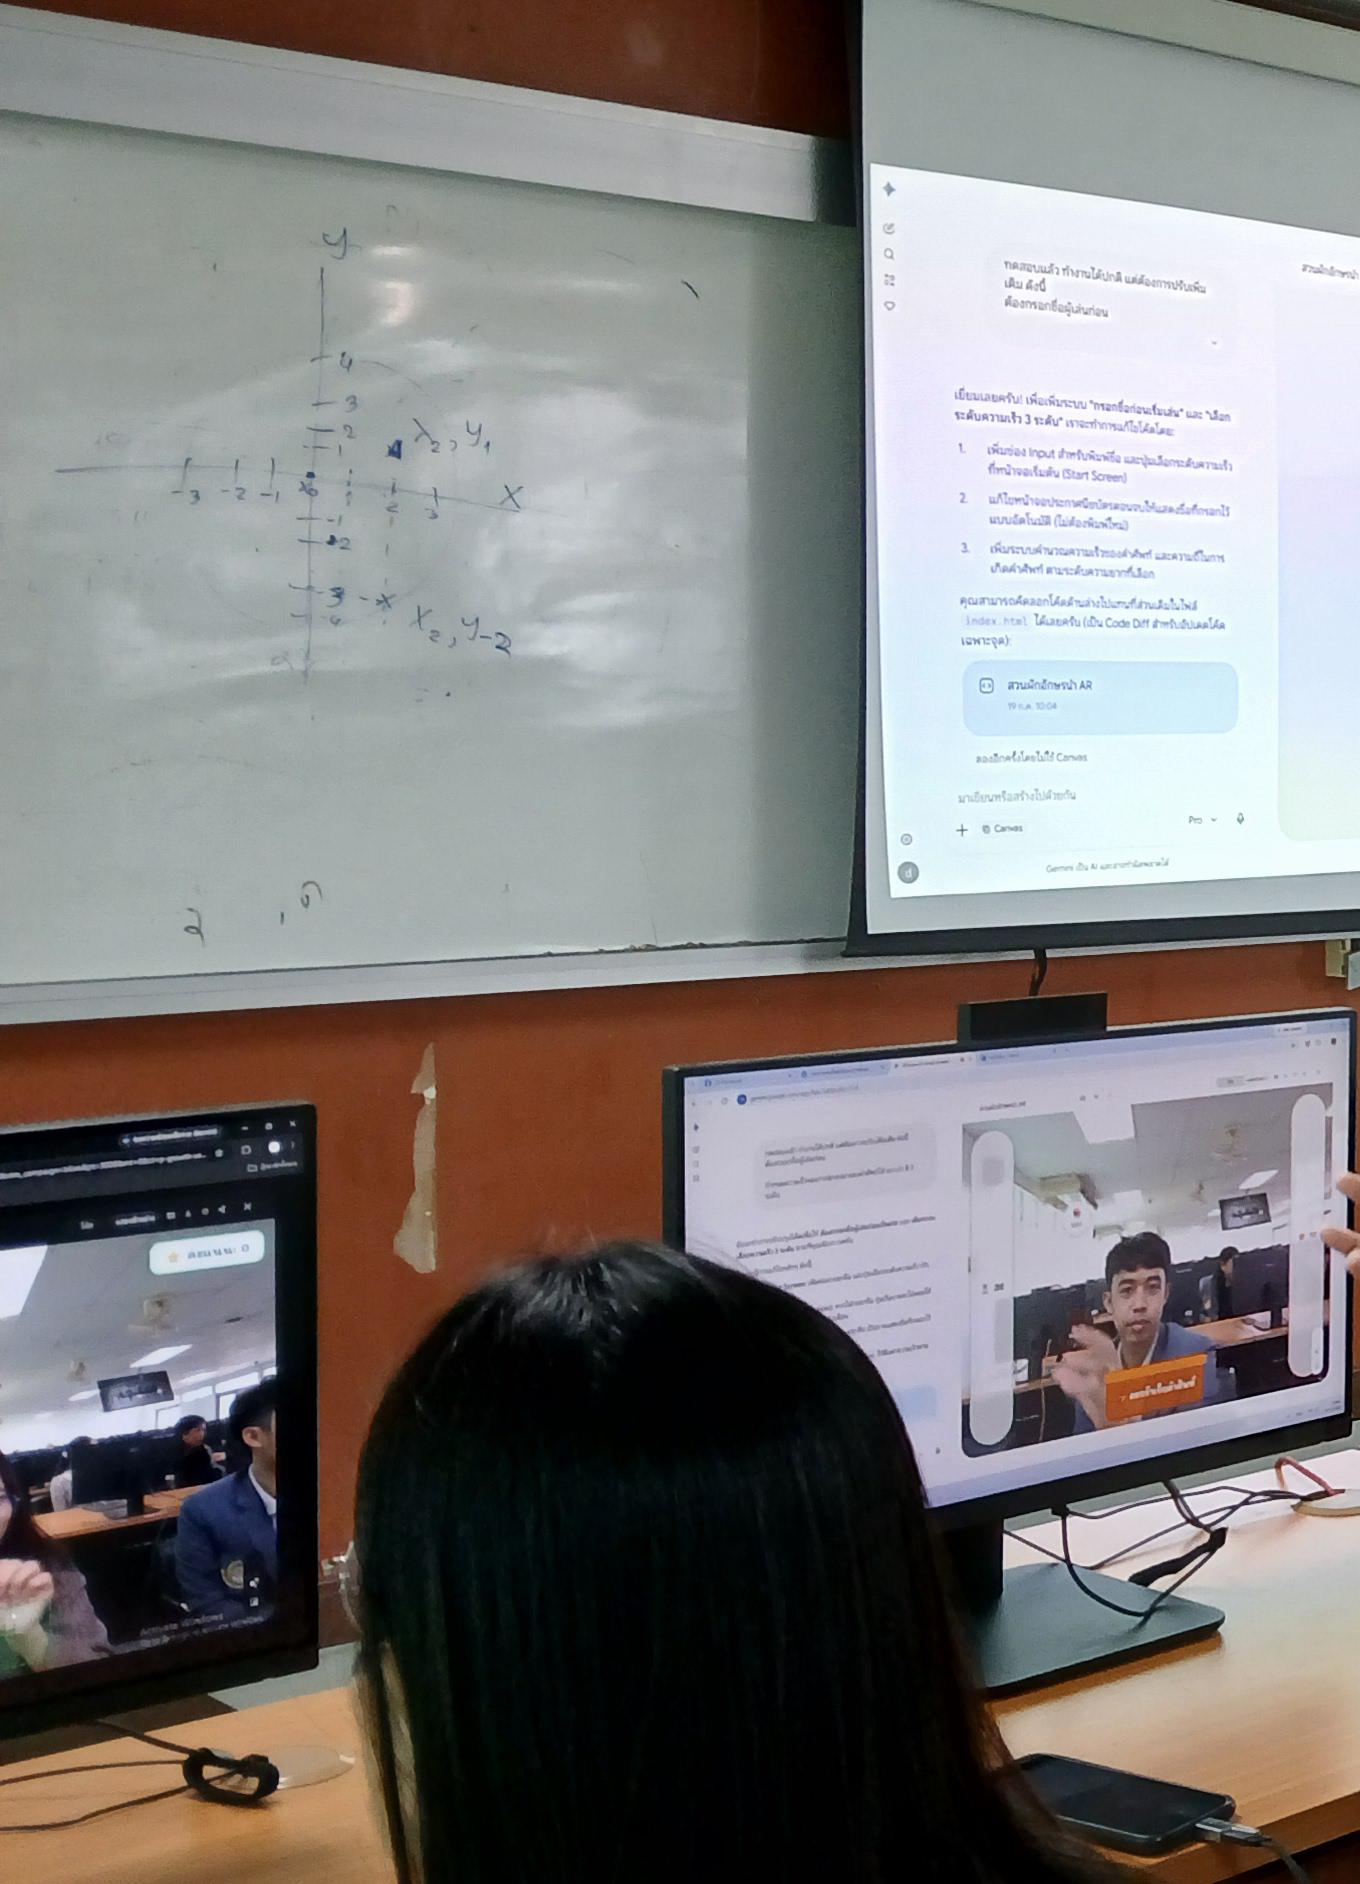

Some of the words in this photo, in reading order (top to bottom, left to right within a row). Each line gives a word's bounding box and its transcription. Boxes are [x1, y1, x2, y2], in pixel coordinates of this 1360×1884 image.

[1025, 414, 1032, 425] 3
[1029, 447, 1055, 460] Input
[1105, 617, 1131, 629] Code
[1079, 680, 1093, 690] AR
